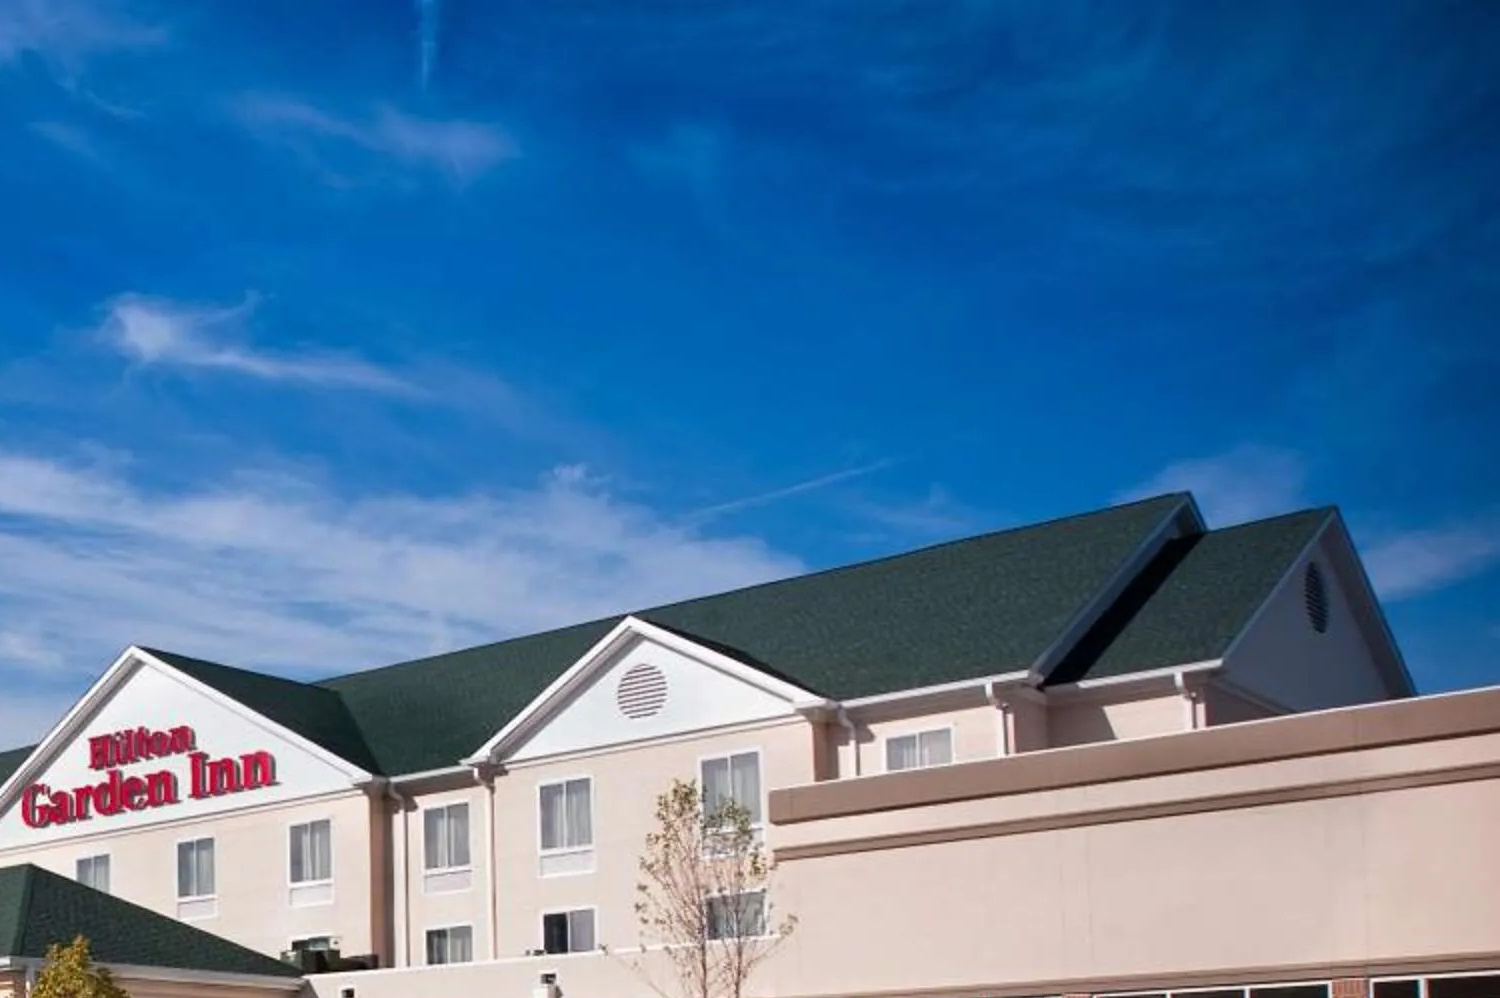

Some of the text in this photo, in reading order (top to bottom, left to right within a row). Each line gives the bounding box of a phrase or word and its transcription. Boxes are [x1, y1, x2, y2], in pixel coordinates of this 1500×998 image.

[88, 725, 197, 771] Hilton
[21, 750, 279, 828] Garden Inn
